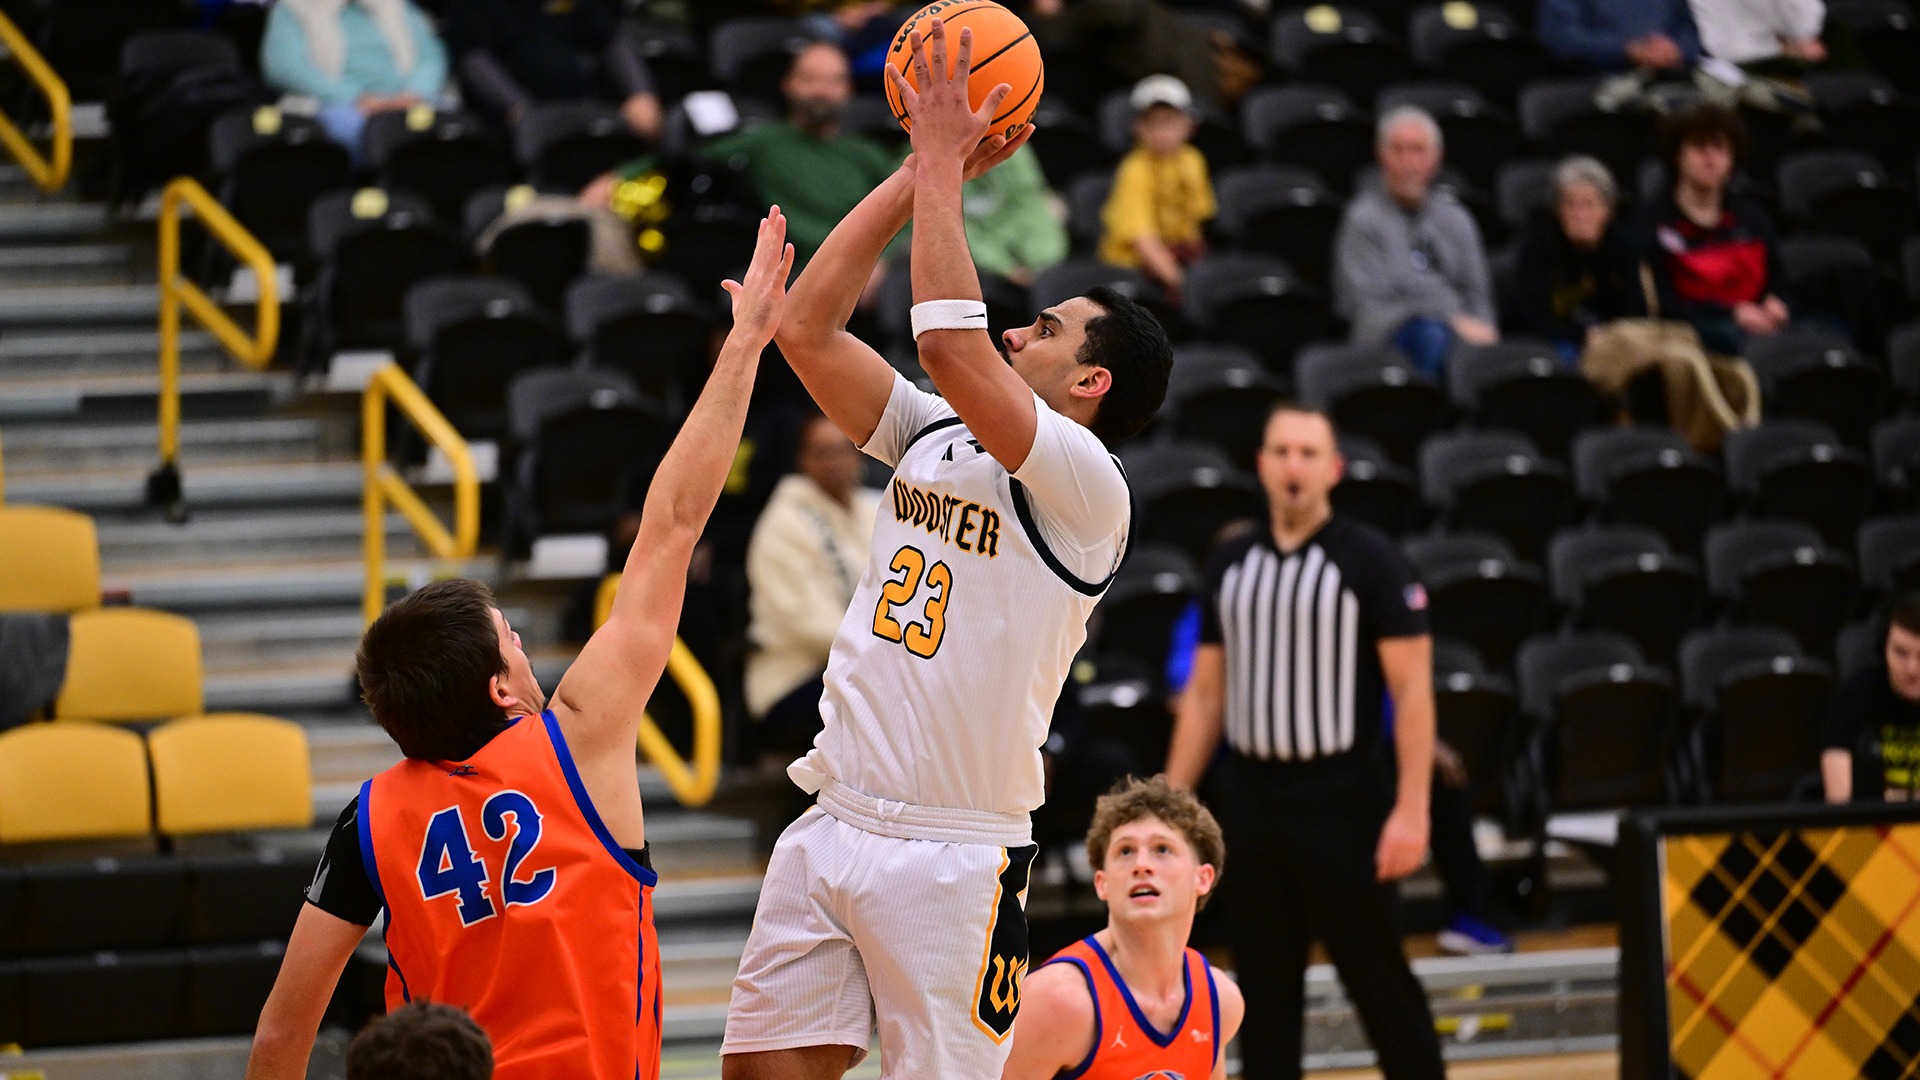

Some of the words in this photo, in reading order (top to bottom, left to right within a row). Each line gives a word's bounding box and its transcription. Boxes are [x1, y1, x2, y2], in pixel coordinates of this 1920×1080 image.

[872, 544, 953, 660] 23
[416, 789, 557, 929] 42
[989, 953, 1025, 1015] W
